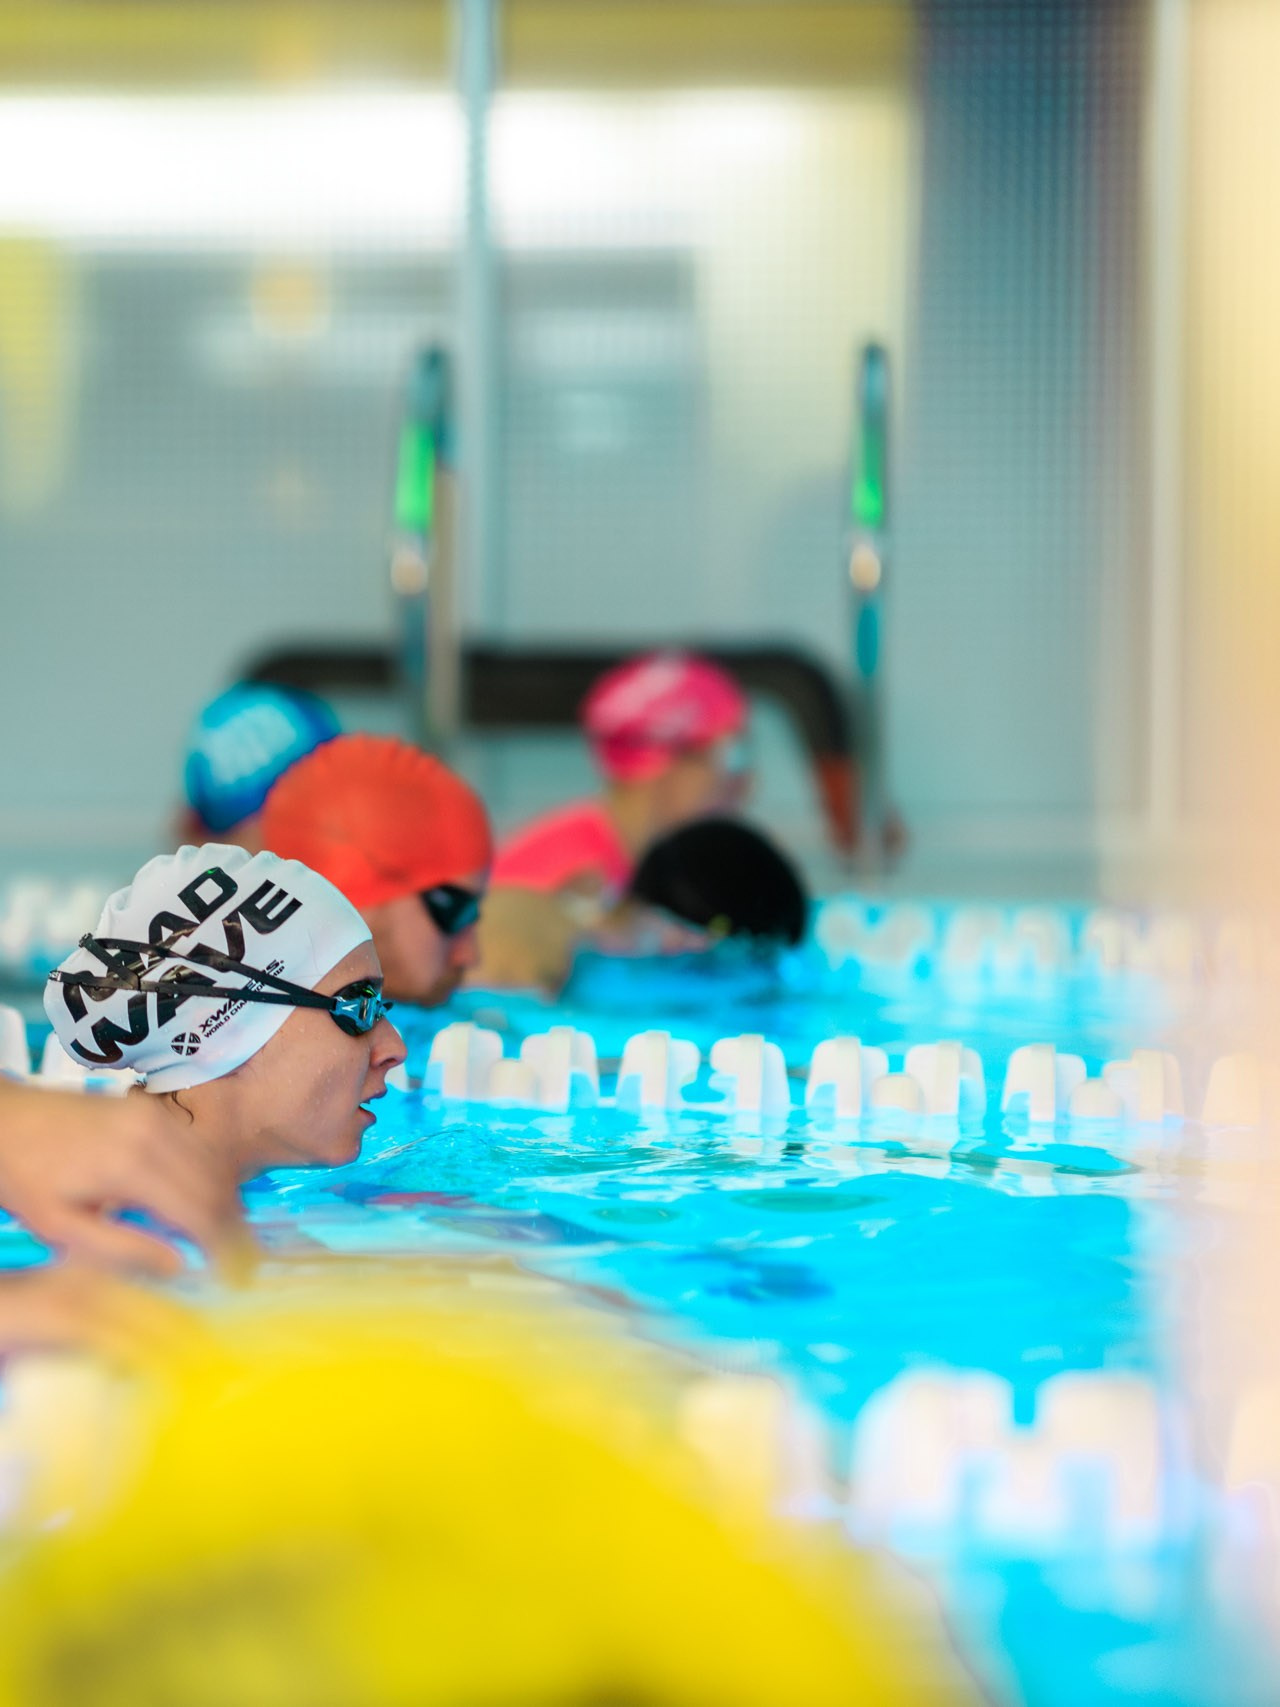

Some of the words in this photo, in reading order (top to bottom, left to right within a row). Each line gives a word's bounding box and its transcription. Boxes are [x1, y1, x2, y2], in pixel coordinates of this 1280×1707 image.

[63, 866, 238, 1023] MAD
[70, 879, 303, 1063] WAVE
[203, 1015, 231, 1039] WORLD
